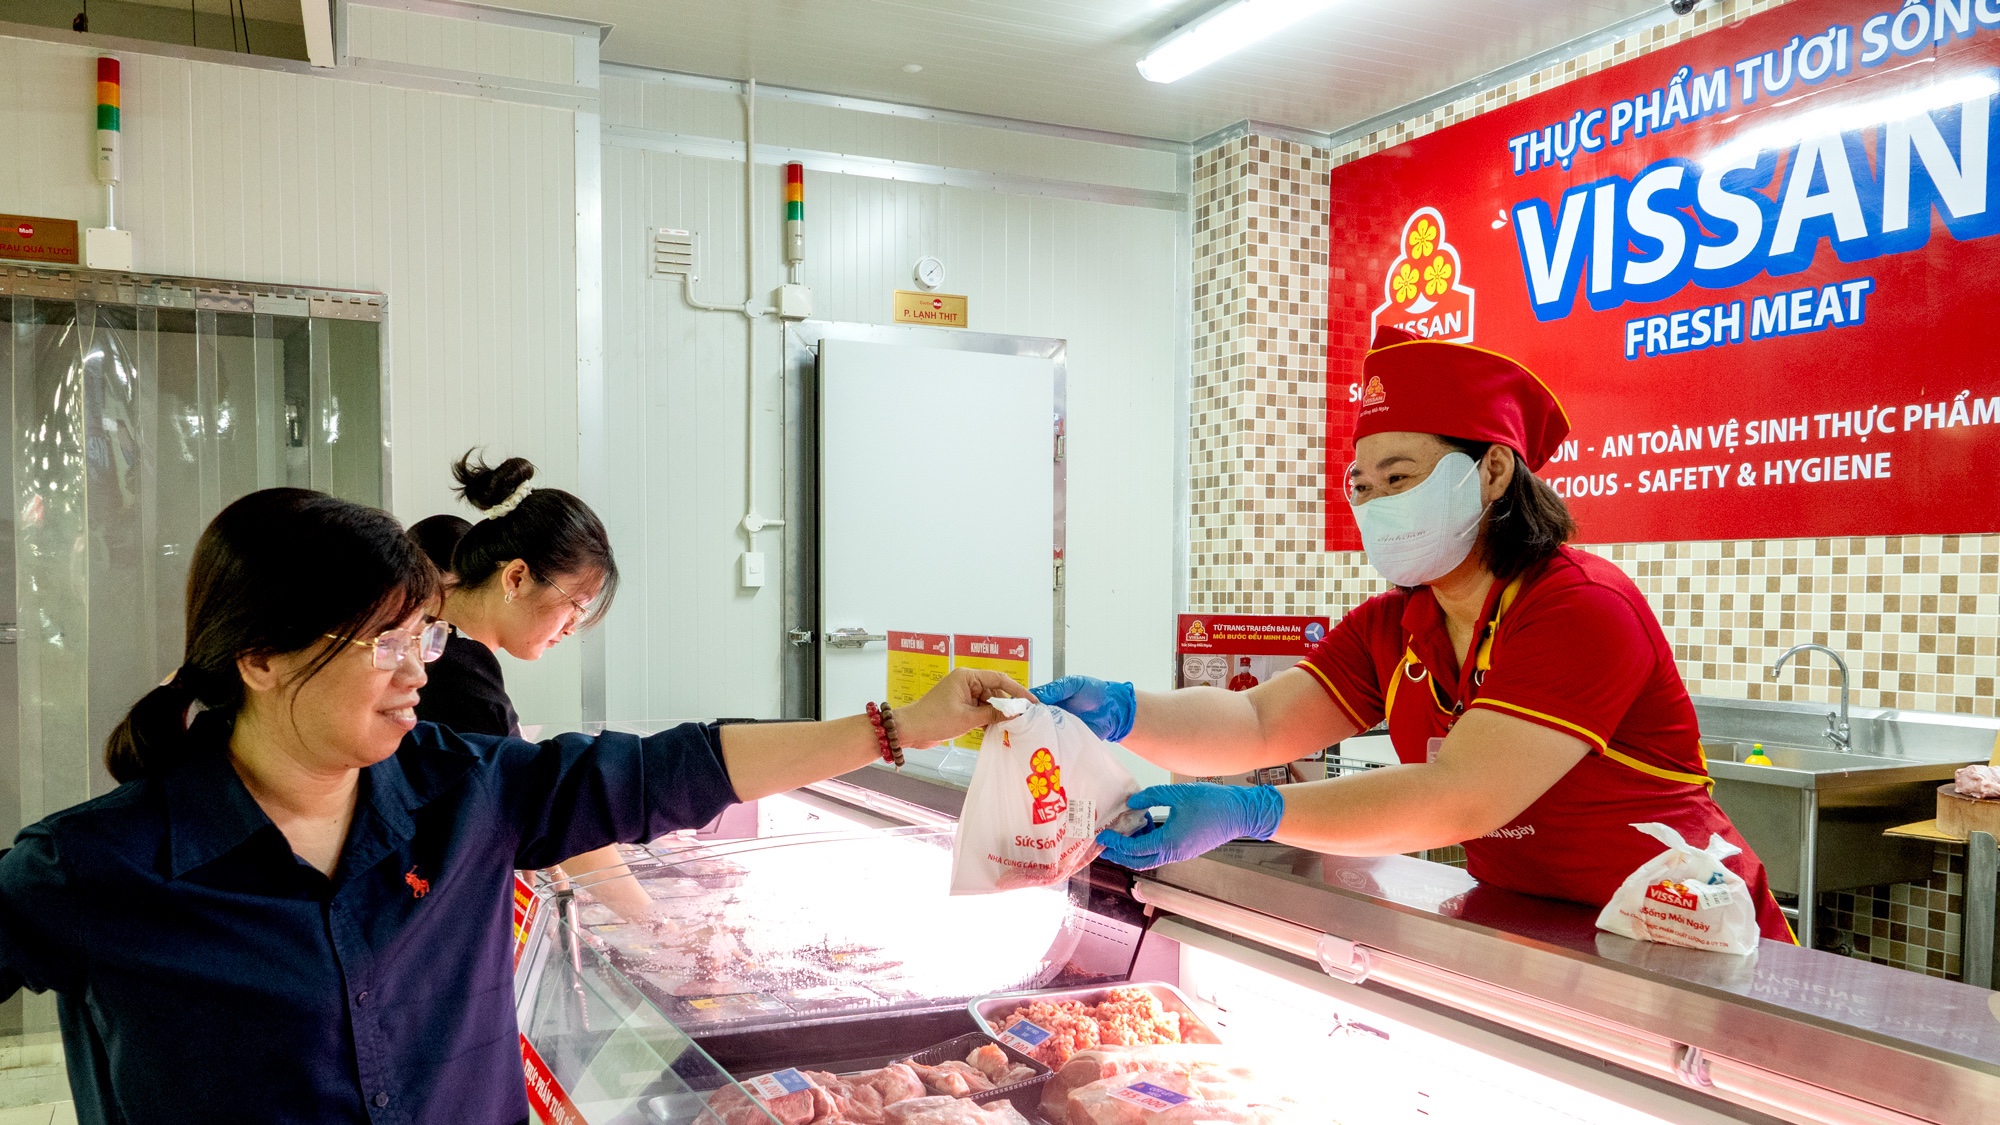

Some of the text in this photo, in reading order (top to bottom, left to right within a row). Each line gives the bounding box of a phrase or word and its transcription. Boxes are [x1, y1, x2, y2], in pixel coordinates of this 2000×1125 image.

[1509, 110, 1602, 172] THỰC
[1611, 67, 1726, 142] PHẨM
[1736, 28, 1847, 100] TƯƠI
[1517, 82, 1990, 305] VISSAN
[903, 309, 958, 322] P. LẠNH THỊT
[1626, 281, 1870, 356] FRESH MEAT
[1602, 434, 1633, 459] AN
[1638, 424, 1703, 455] TOÀN
[1708, 418, 1739, 454] VỆ
[1745, 416, 1808, 446] SINH
[1814, 405, 1896, 443] THỰC
[1903, 389, 2000, 432] PHẨM
[1638, 464, 1731, 494] SAFETY
[1737, 462, 1757, 486] &
[1764, 452, 1891, 485] HYGIENE
[1223, 624, 1246, 632] TRANG
[1015, 835, 1056, 850] Sức Sốn
[1500, 824, 1536, 840] Ngày
[1003, 858, 1023, 868] CUNG
[1650, 888, 1693, 909] VISSAN
[1668, 912, 1685, 925] Mỗi
[1686, 916, 1711, 933] Ngày
[524, 1058, 539, 1087] THỰC
[535, 1075, 552, 1108] PHẨM
